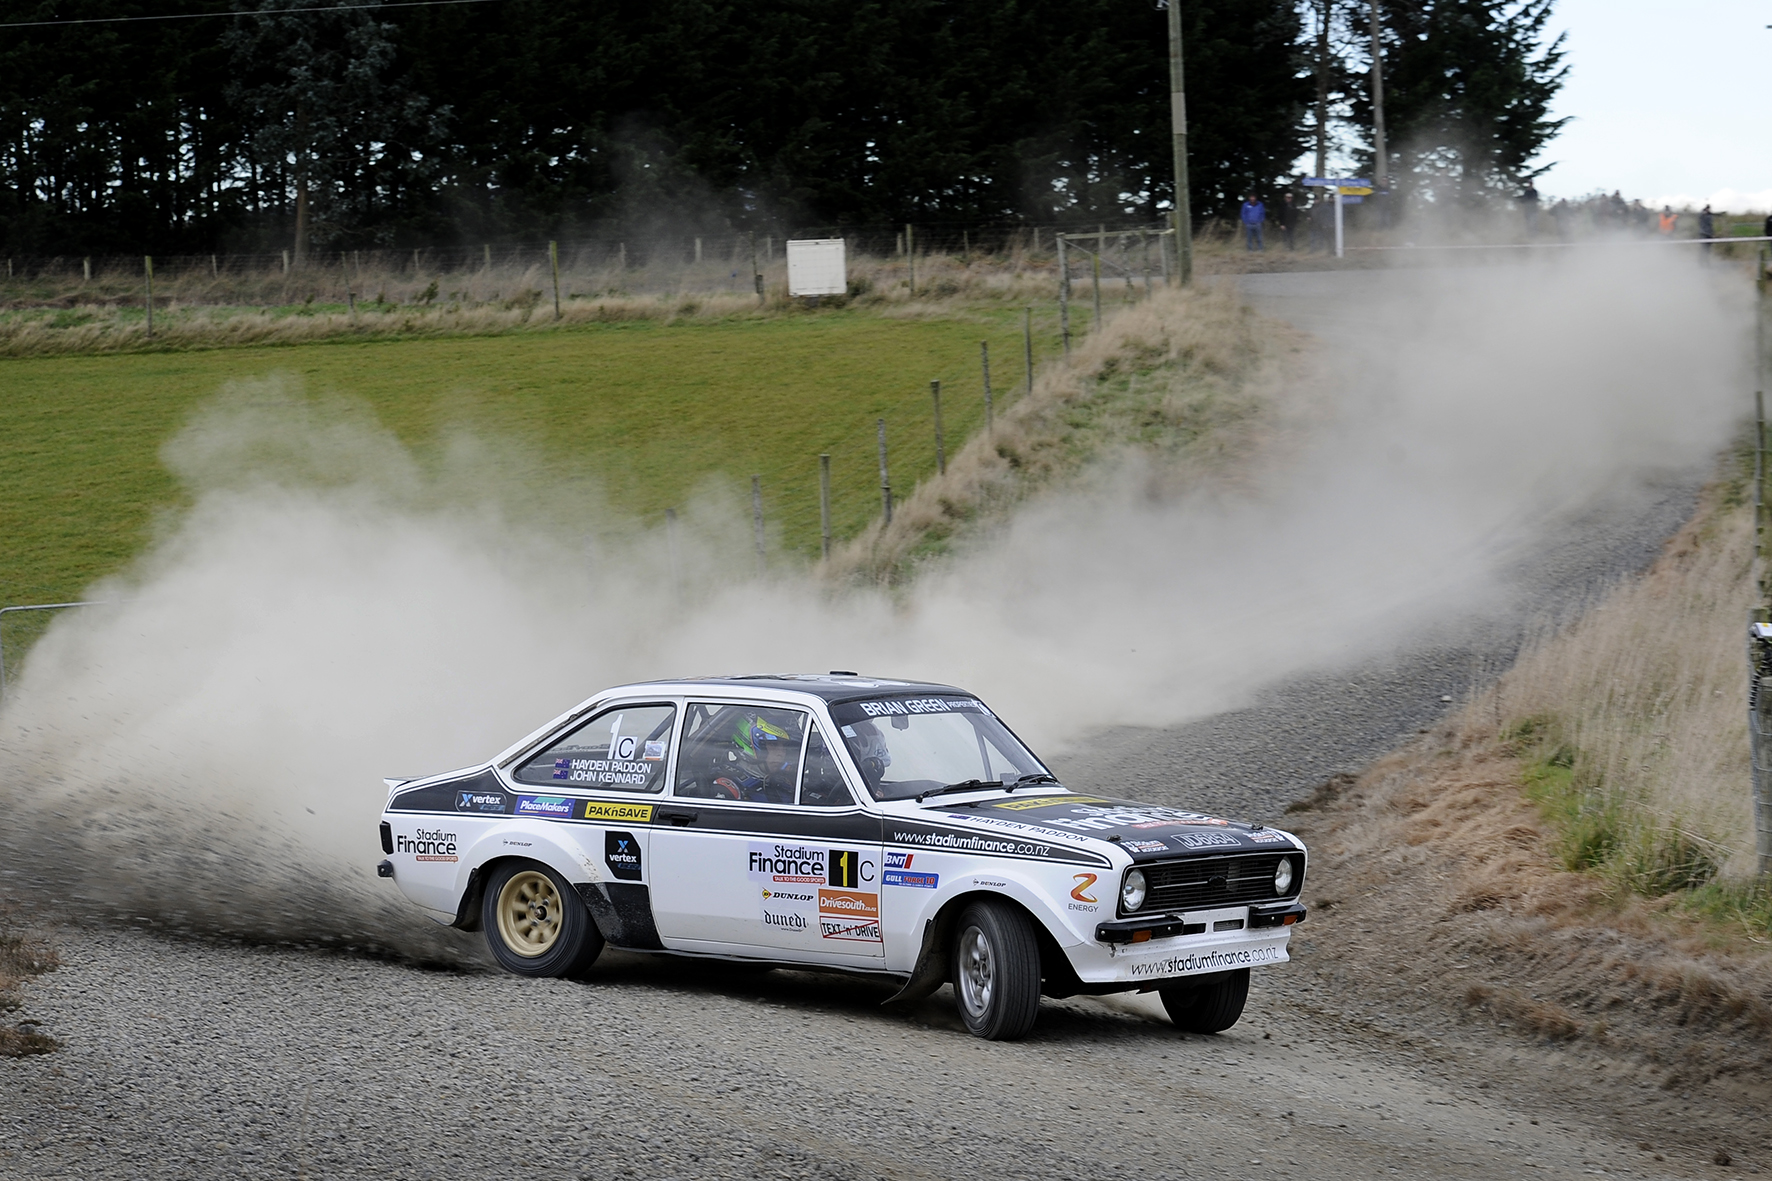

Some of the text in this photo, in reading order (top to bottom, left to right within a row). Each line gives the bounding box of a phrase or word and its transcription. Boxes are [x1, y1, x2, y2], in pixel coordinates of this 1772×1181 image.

[860, 701, 909, 716] BRIAN
[905, 699, 951, 713] GREEN
[607, 713, 624, 760] 1
[618, 737, 634, 759] C
[571, 759, 651, 774] HAYDEN PADDON
[570, 770, 645, 785] JOHN KENNARD
[472, 794, 501, 805] vertex
[519, 799, 570, 813] PlaceMakers
[416, 828, 456, 841] Stadium
[969, 817, 1089, 843] HAYDEN PADDON
[397, 835, 456, 854] Finance
[893, 831, 1050, 856] www.stadiumfinance.co.nz
[1181, 832, 1236, 847] JD6854
[609, 853, 637, 863] vertex
[774, 844, 824, 861] Stadium
[885, 854, 905, 866] BNT
[750, 852, 824, 876] Finance
[840, 851, 875, 887] 1 C
[886, 874, 902, 882] GULL
[903, 876, 925, 884] FORCE
[926, 876, 935, 885] 10
[773, 892, 814, 901] DUNLOP
[1068, 903, 1098, 913] ENERGY
[822, 923, 840, 935] TEXT
[856, 926, 880, 938] DRIVE
[1131, 946, 1278, 976] www.stadiumfinance.co.nz
